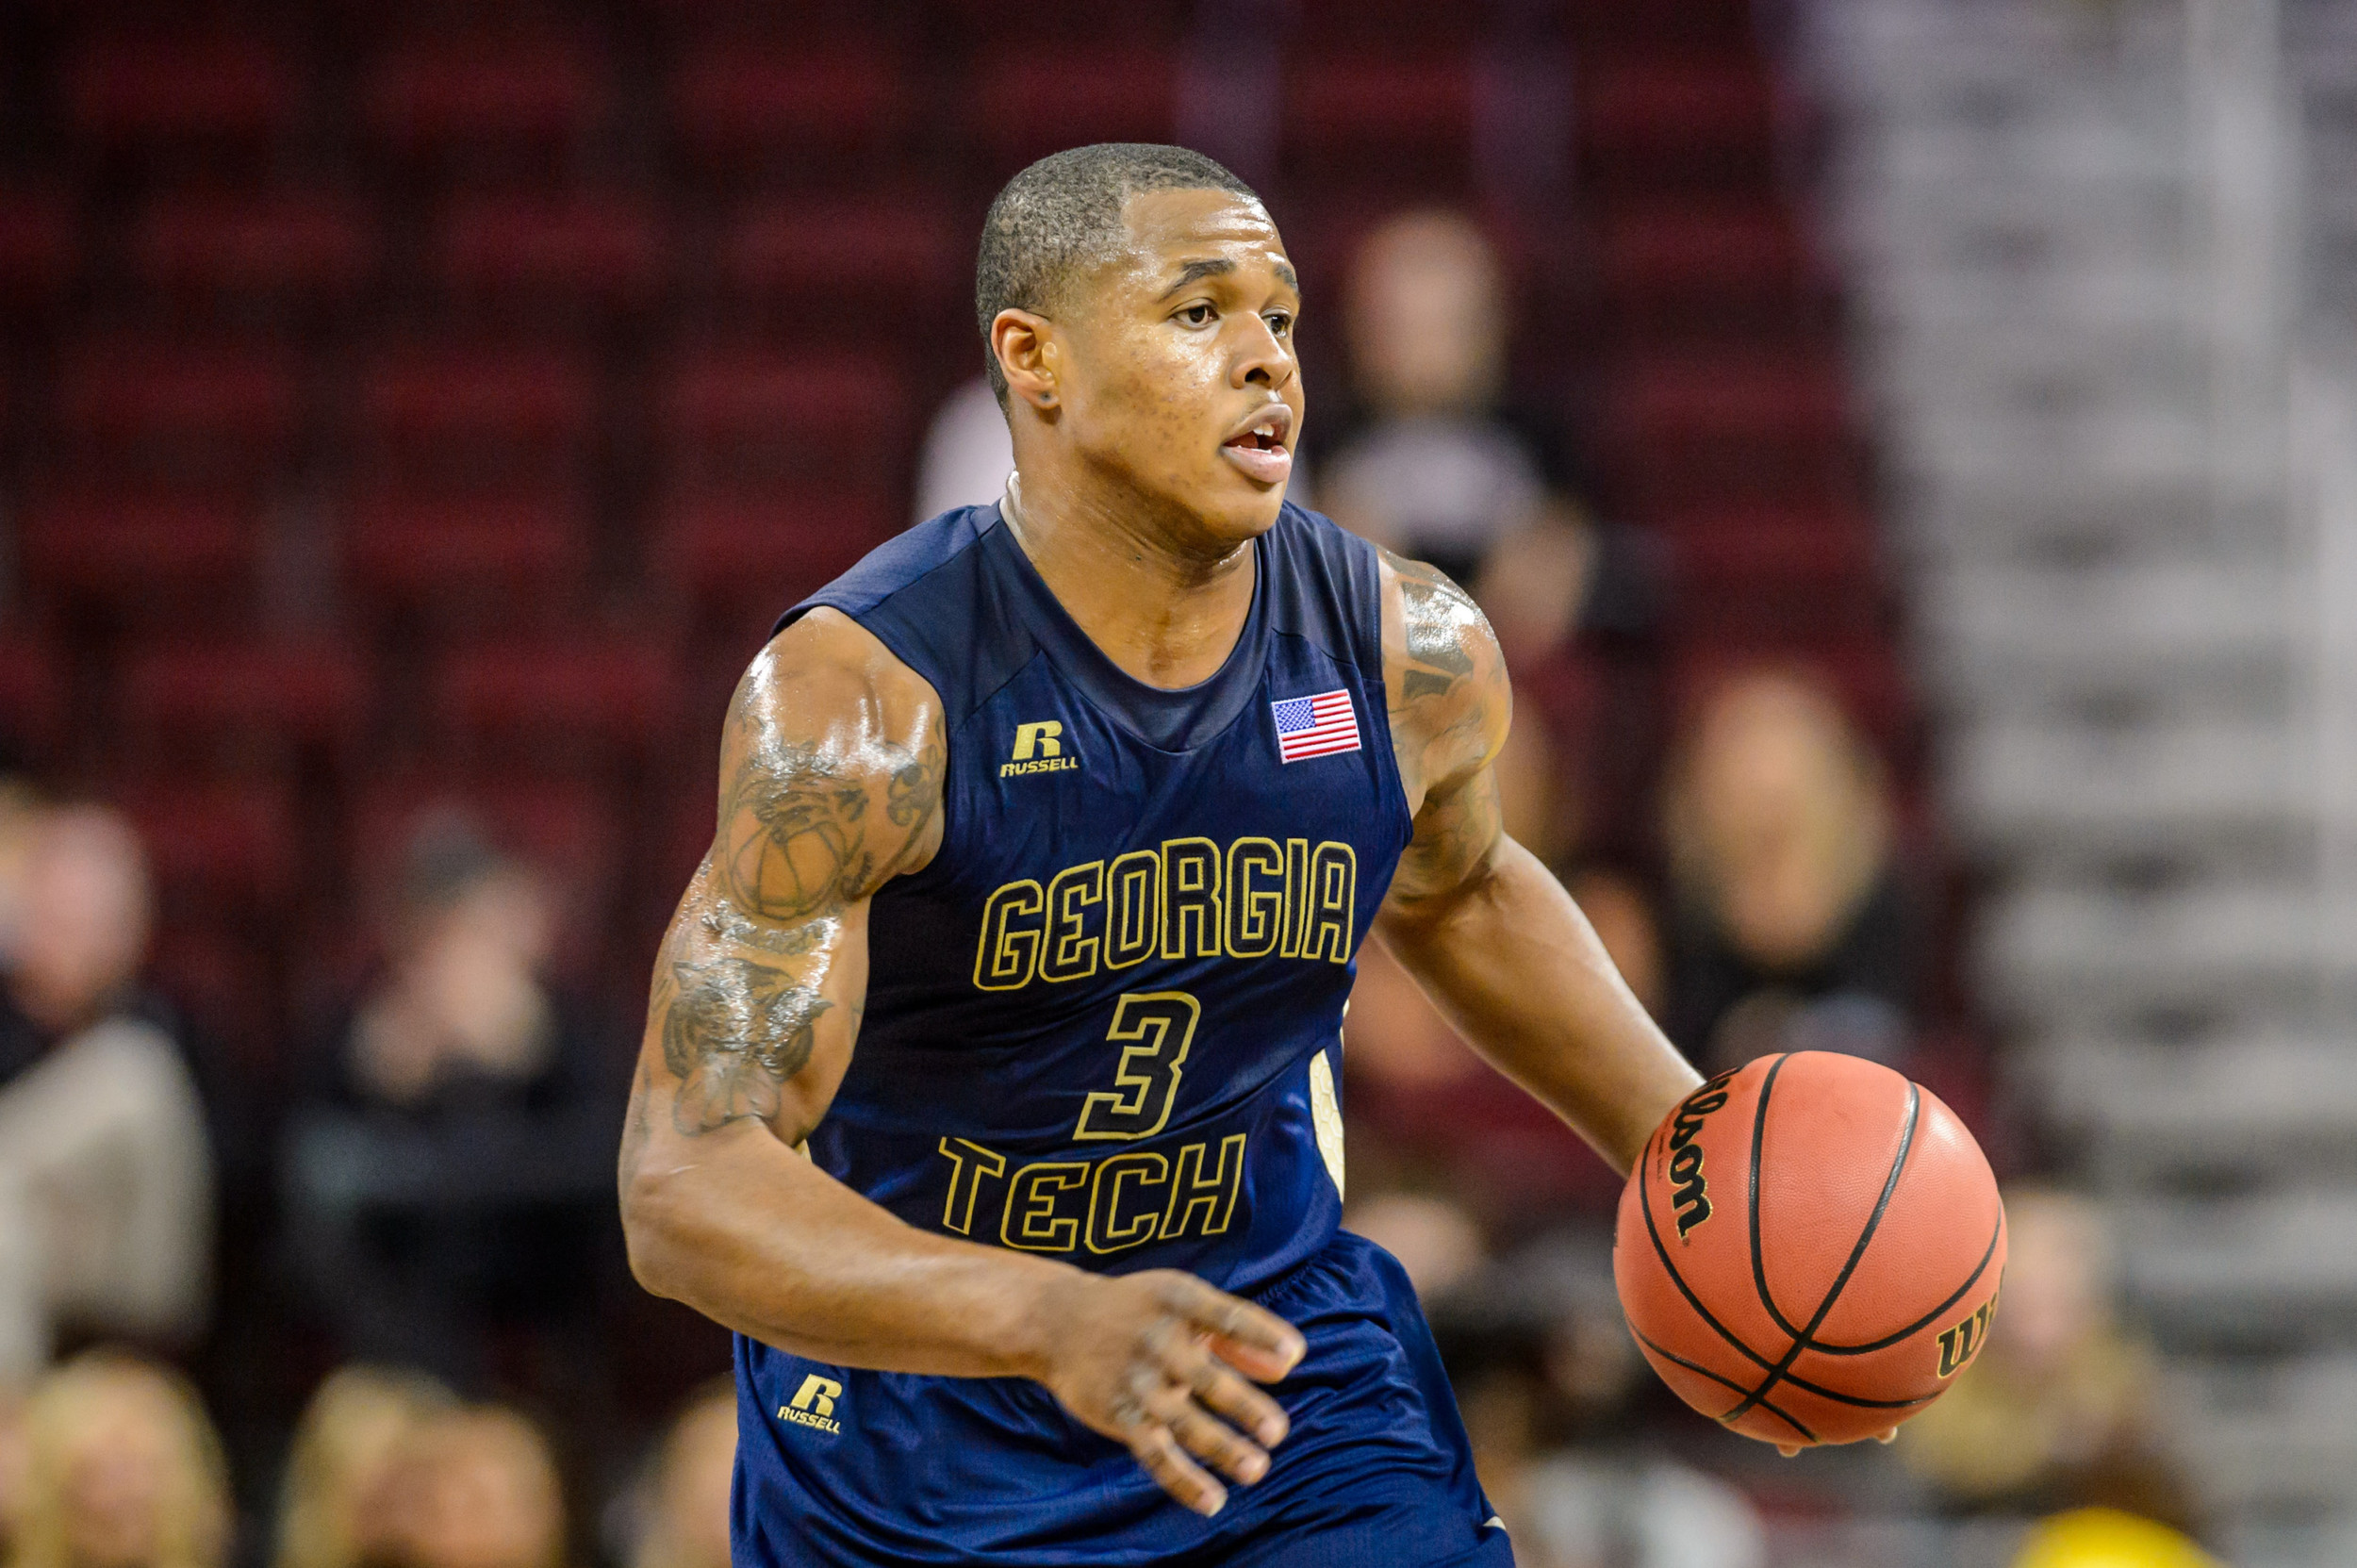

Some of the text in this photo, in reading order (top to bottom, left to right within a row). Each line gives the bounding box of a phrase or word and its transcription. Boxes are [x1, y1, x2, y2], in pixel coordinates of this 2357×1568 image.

[999, 756, 1079, 778] RUSSELL
[973, 836, 1356, 991] GEORGIA
[1073, 991, 1200, 1141] 3
[939, 1132, 1246, 1255] TECH
[1668, 1067, 1743, 1241] ilson
[777, 1405, 841, 1434] RUSSELL
